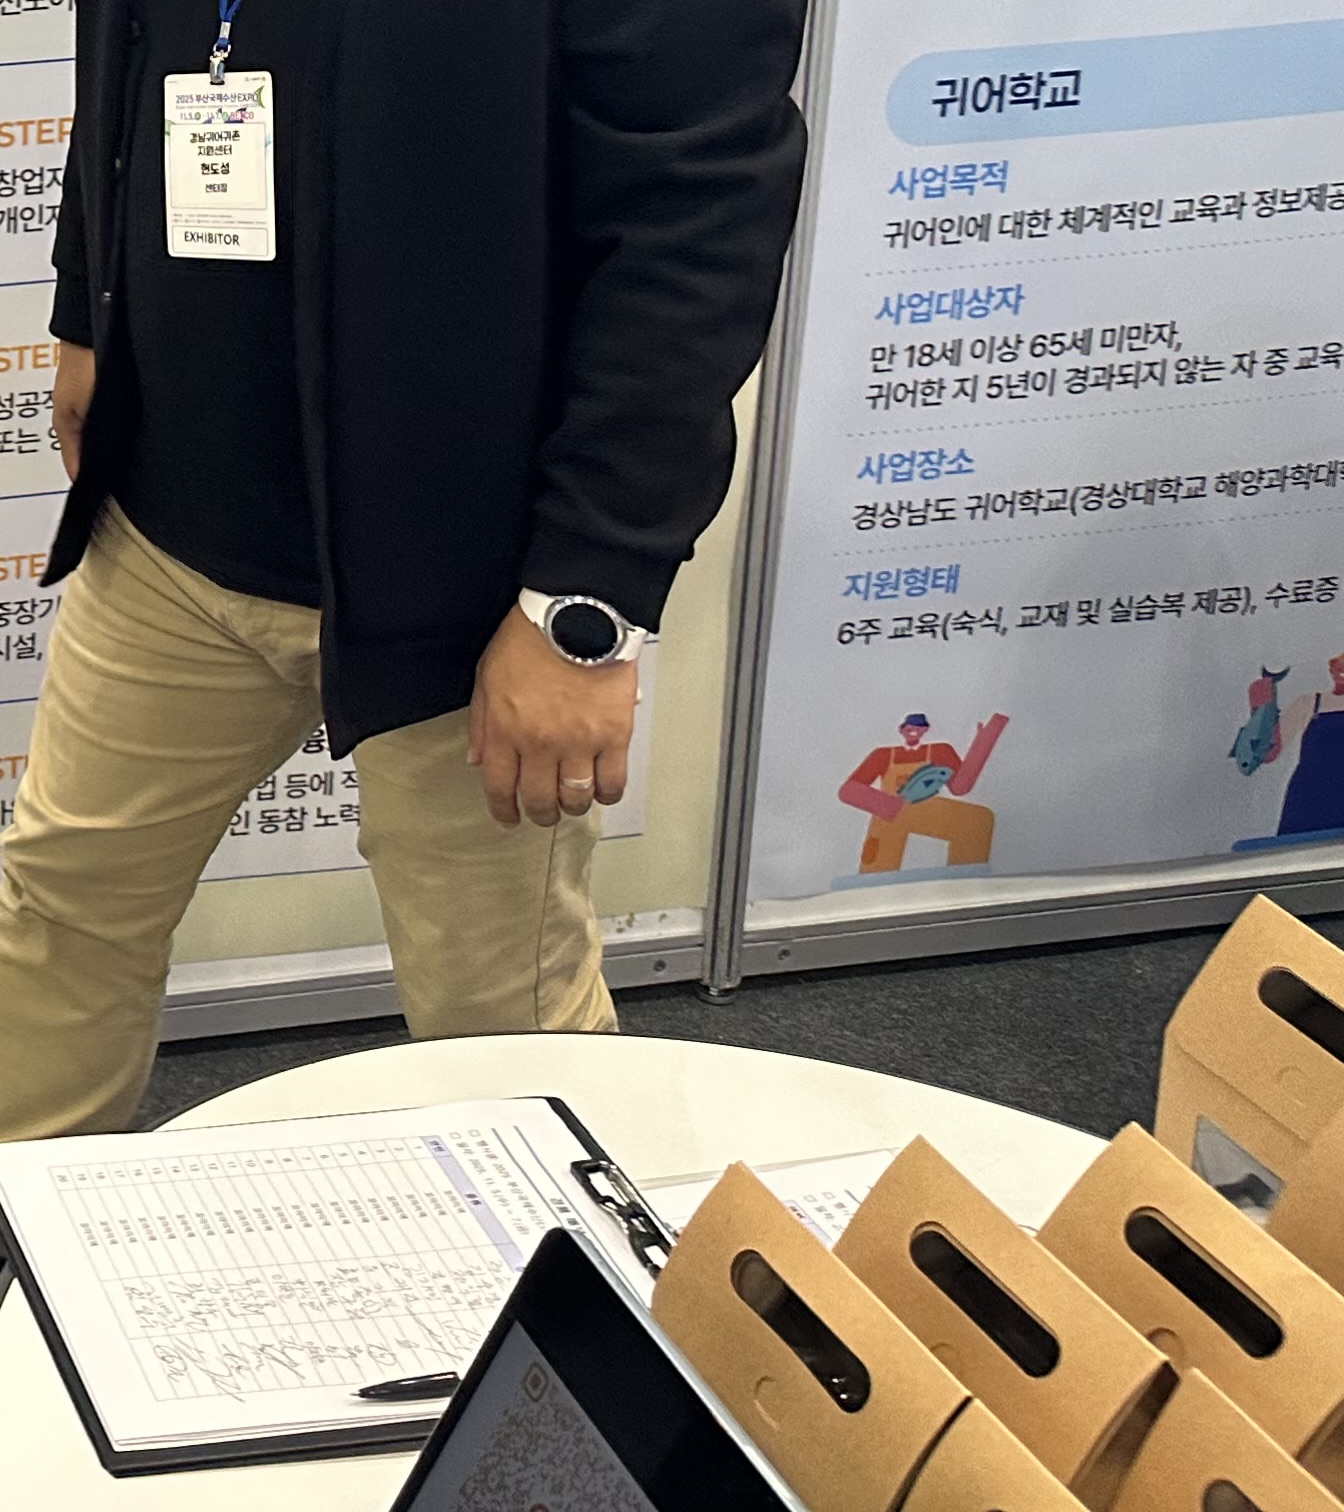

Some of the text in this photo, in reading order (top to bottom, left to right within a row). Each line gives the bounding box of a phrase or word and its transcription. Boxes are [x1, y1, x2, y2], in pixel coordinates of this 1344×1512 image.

[932, 69, 1082, 118] 귀어학교
[888, 159, 1009, 201] 사업목적
[184, 231, 240, 246] EXHIBITOR
[883, 191, 1248, 249] 귀어인에 대한 체계적인 교육과
[874, 283, 1026, 326] 사업대상자
[856, 448, 975, 485] 사업장소
[842, 563, 961, 602] 지원형태
[837, 575, 1339, 646] 6주 교육(숙식, 교재 및 실습복 제공), 수료증
[284, 770, 334, 799] 등에
[257, 806, 308, 833] 동참
